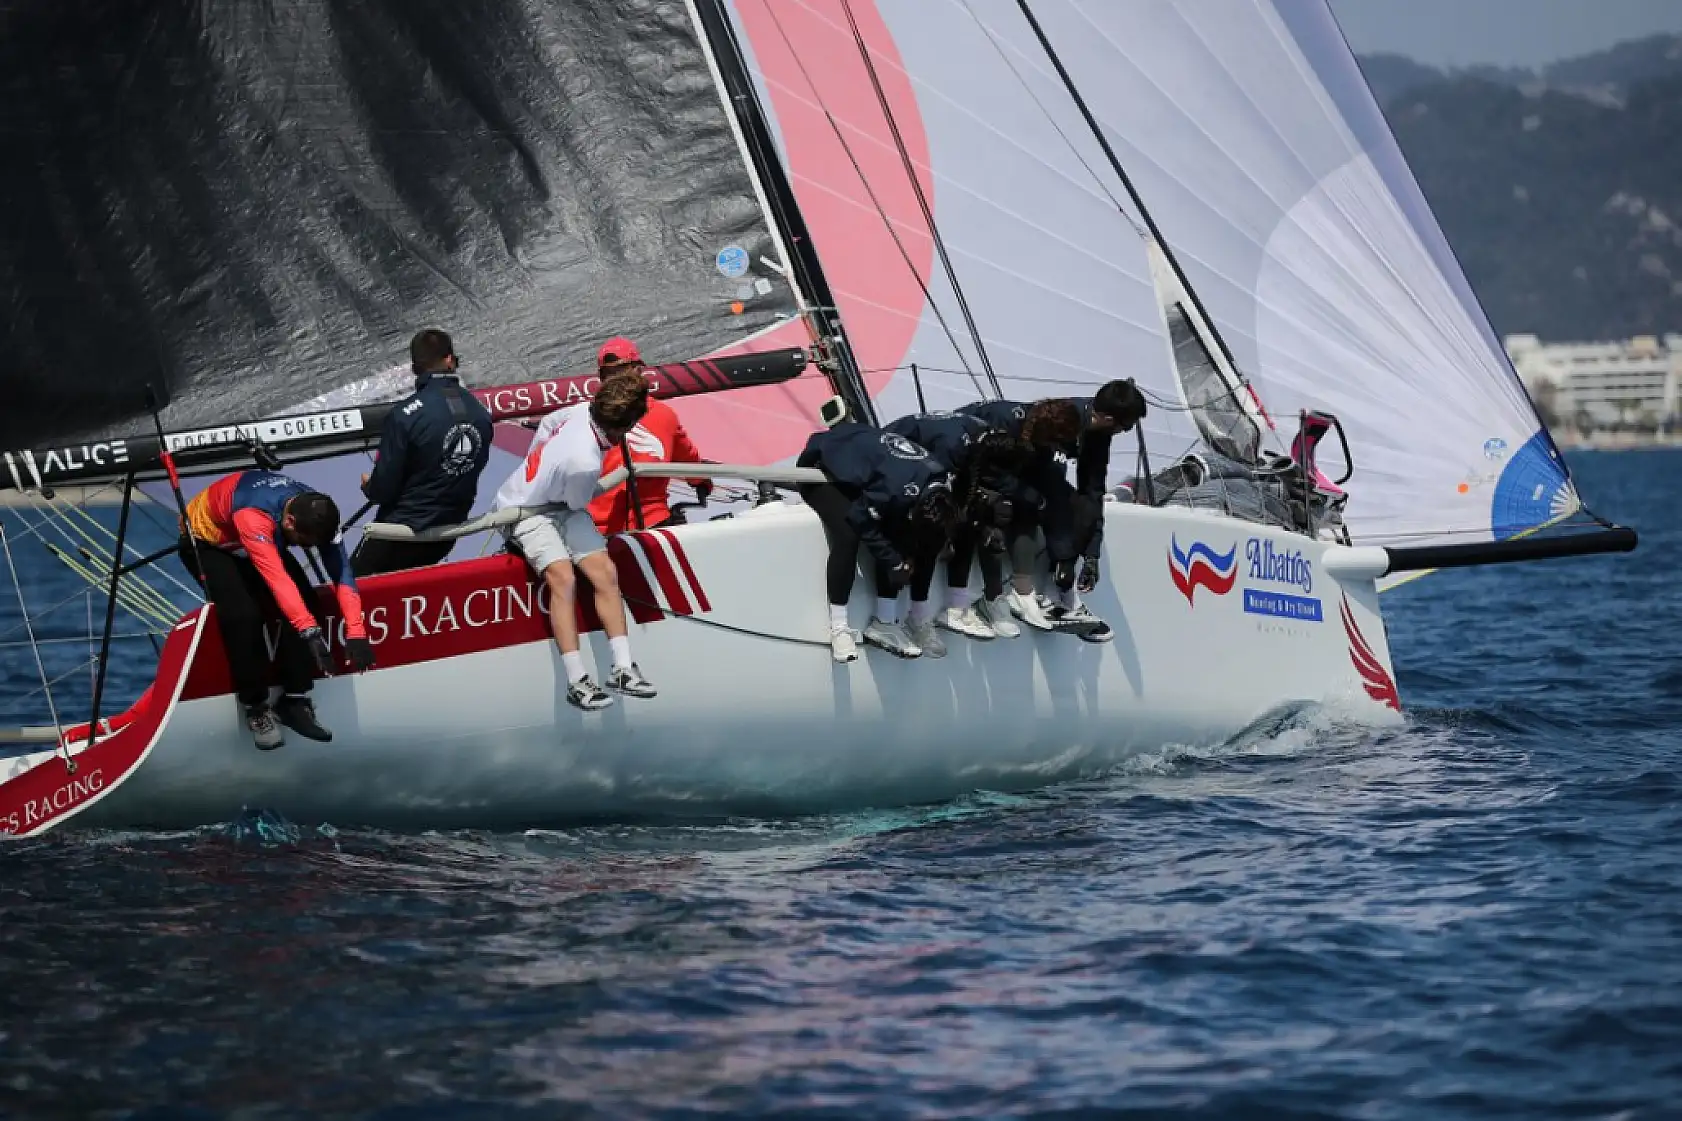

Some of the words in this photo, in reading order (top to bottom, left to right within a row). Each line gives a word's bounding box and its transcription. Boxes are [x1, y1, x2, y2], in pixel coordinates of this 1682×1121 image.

[539, 370, 660, 408] RACG
[283, 413, 352, 437] COFFEE
[43, 440, 130, 474] ALICE
[24, 768, 104, 825] RACING
